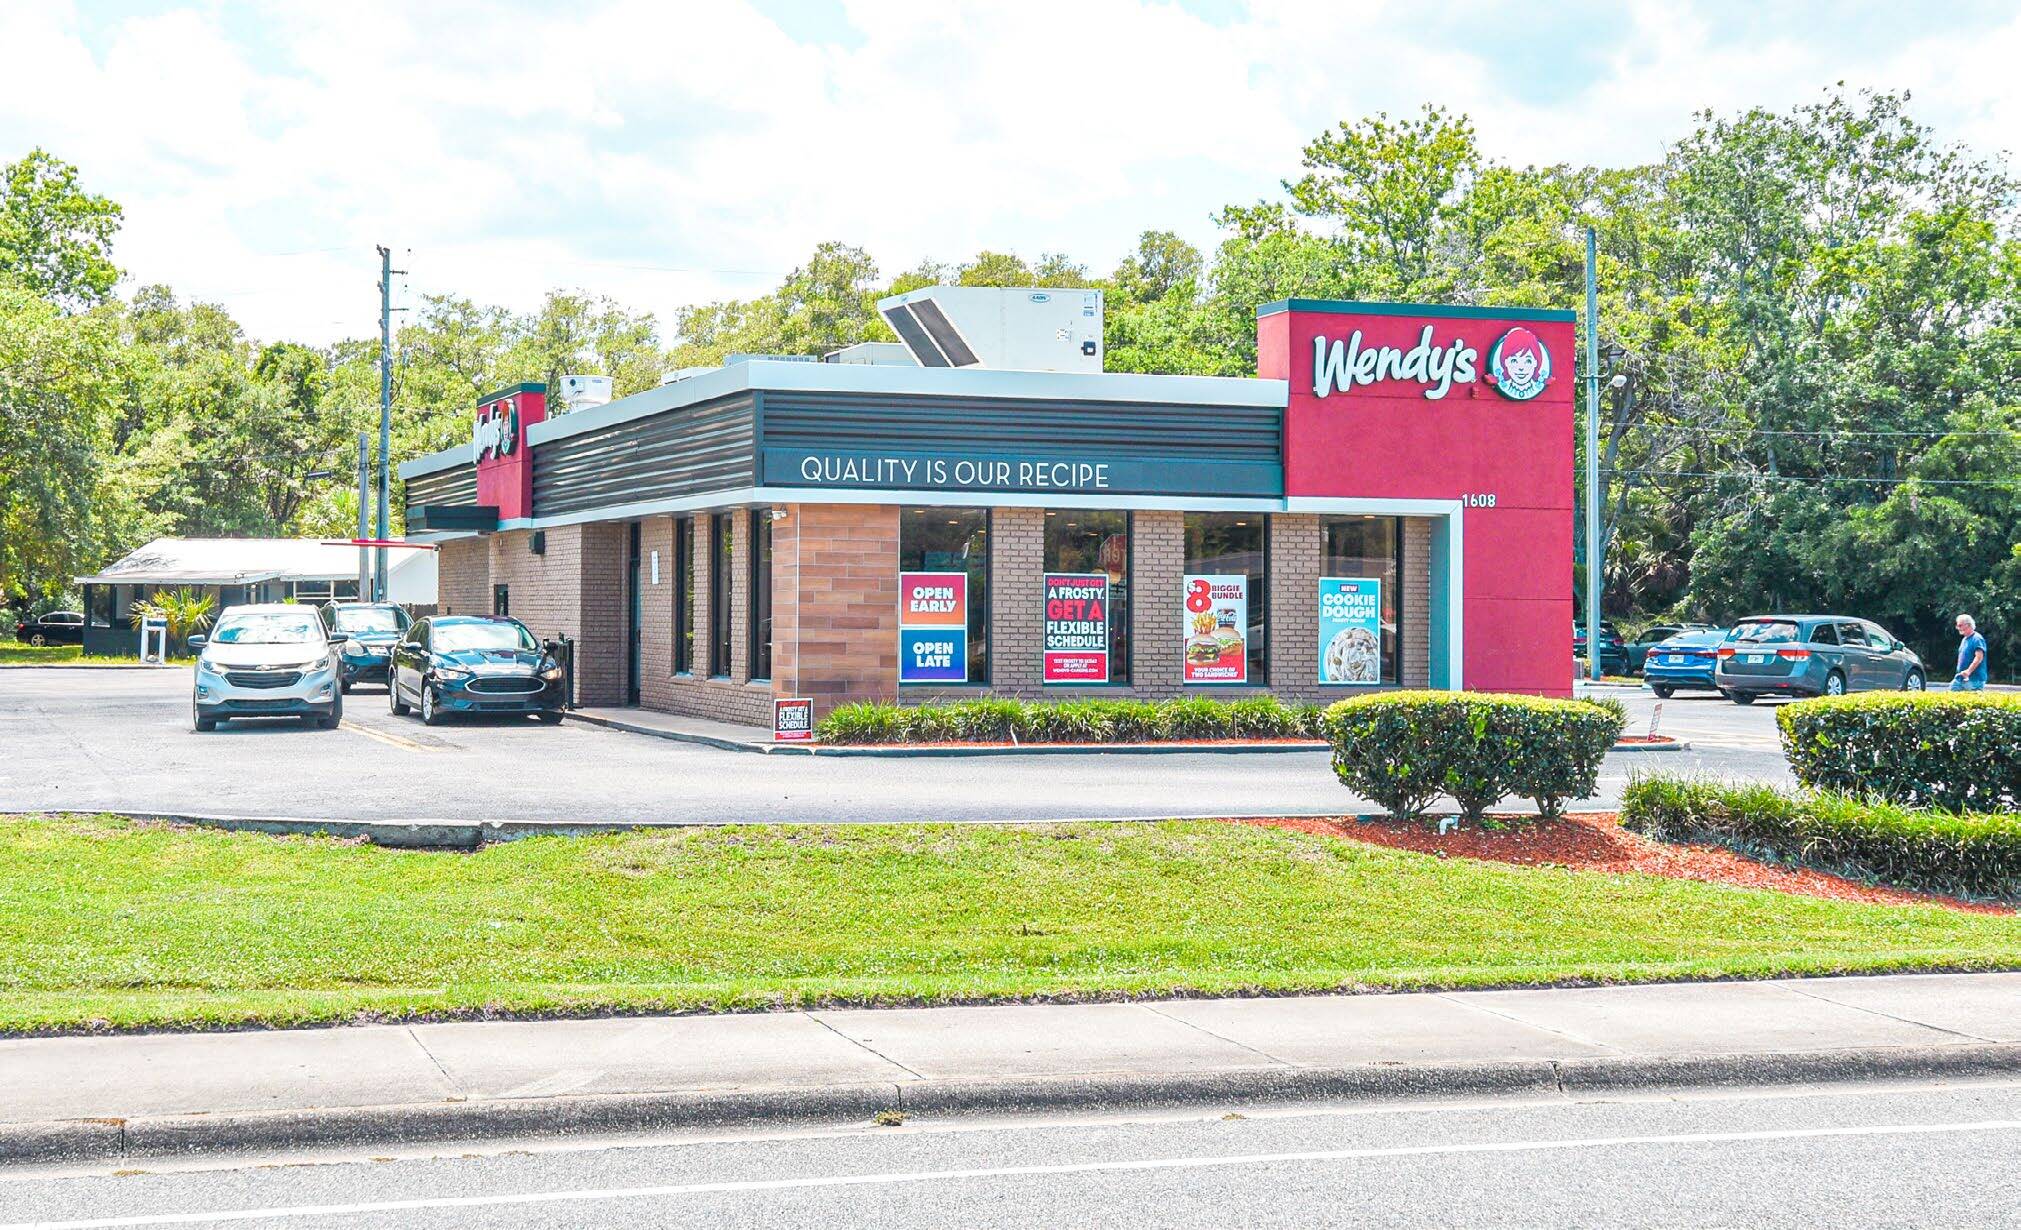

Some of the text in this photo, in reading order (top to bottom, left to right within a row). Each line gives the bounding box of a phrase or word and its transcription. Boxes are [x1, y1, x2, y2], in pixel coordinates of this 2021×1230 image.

[1314, 325, 1477, 400] Wendy's
[801, 456, 1109, 487] QUALITY IS OUR RECIPE
[1462, 494, 1496, 508] 1608
[912, 587, 953, 600] OPEN
[1048, 587, 1105, 600] A FROSTY.
[1211, 592, 1243, 600] BUNDLE
[1322, 593, 1376, 606] COOKIE
[910, 600, 957, 613] EARLY
[1047, 600, 1105, 620] GET A
[1322, 606, 1376, 618] DOUGH
[1046, 621, 1104, 635] FLEXIBLE
[912, 642, 953, 654] OPEN
[916, 655, 951, 667] LATE
[779, 711, 809, 721] FLEXIBLE
